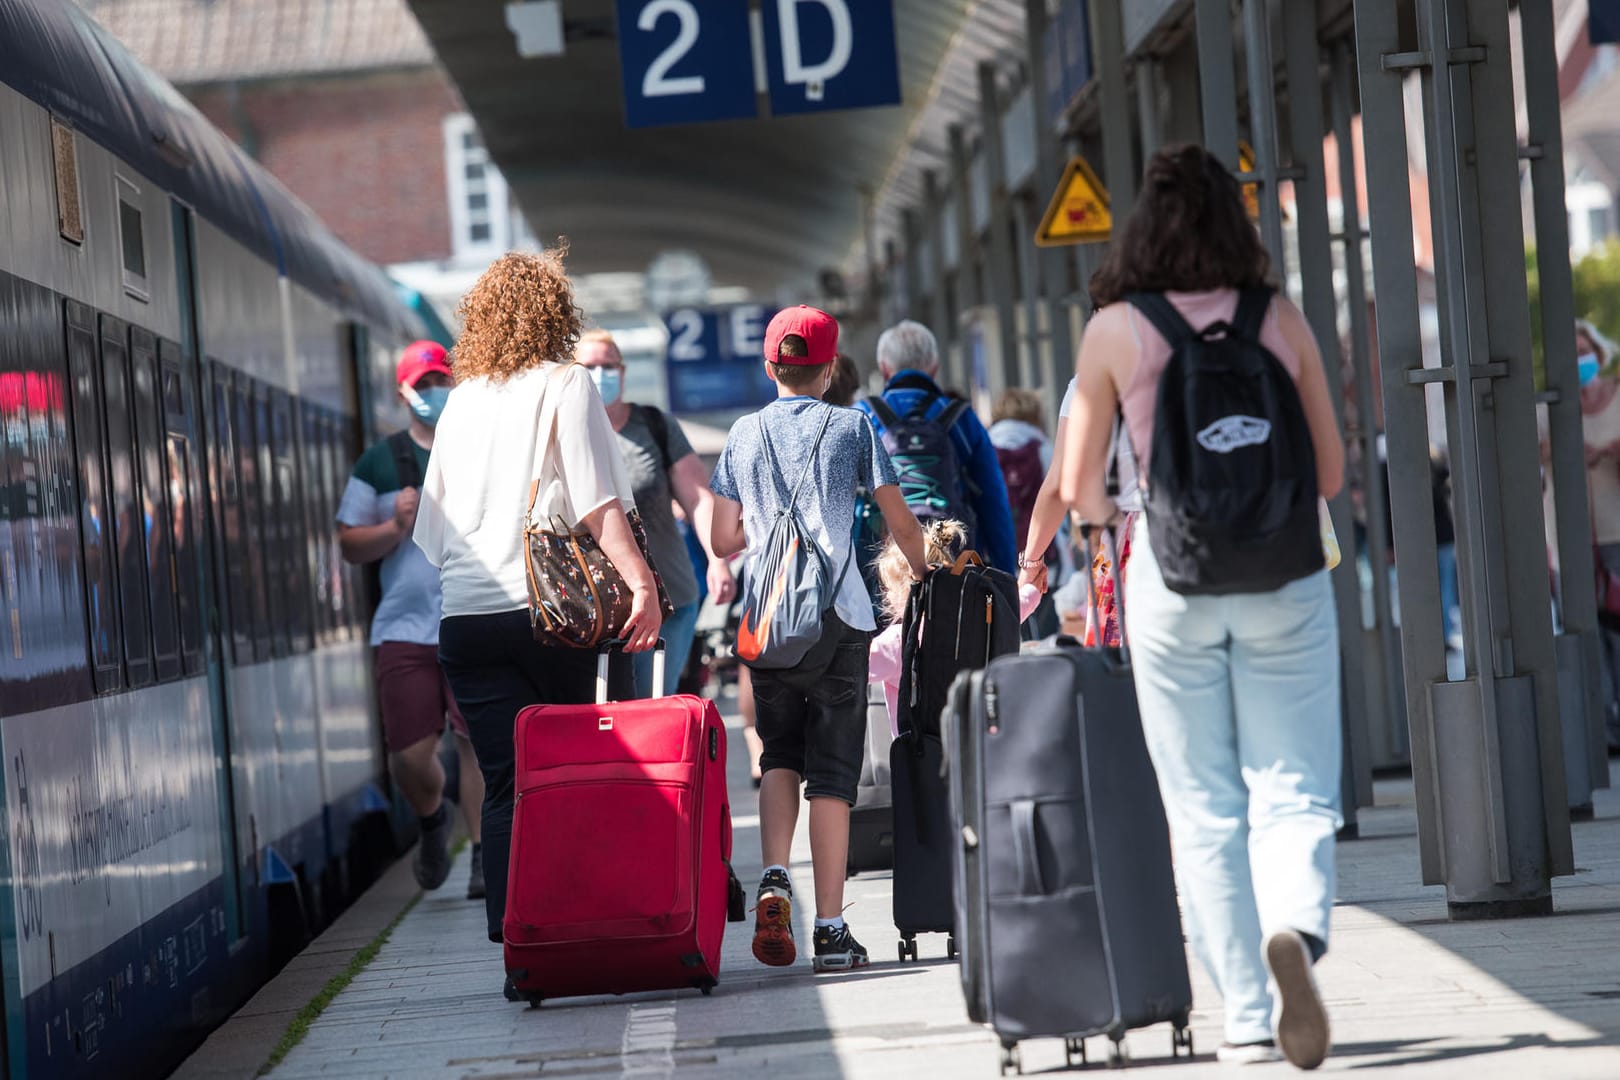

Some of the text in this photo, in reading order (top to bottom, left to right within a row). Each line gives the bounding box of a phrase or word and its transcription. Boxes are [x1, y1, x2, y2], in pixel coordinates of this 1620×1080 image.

[637, 0, 705, 96] 2
[777, 0, 853, 84] D
[670, 308, 706, 360] 2
[731, 305, 766, 357] E
